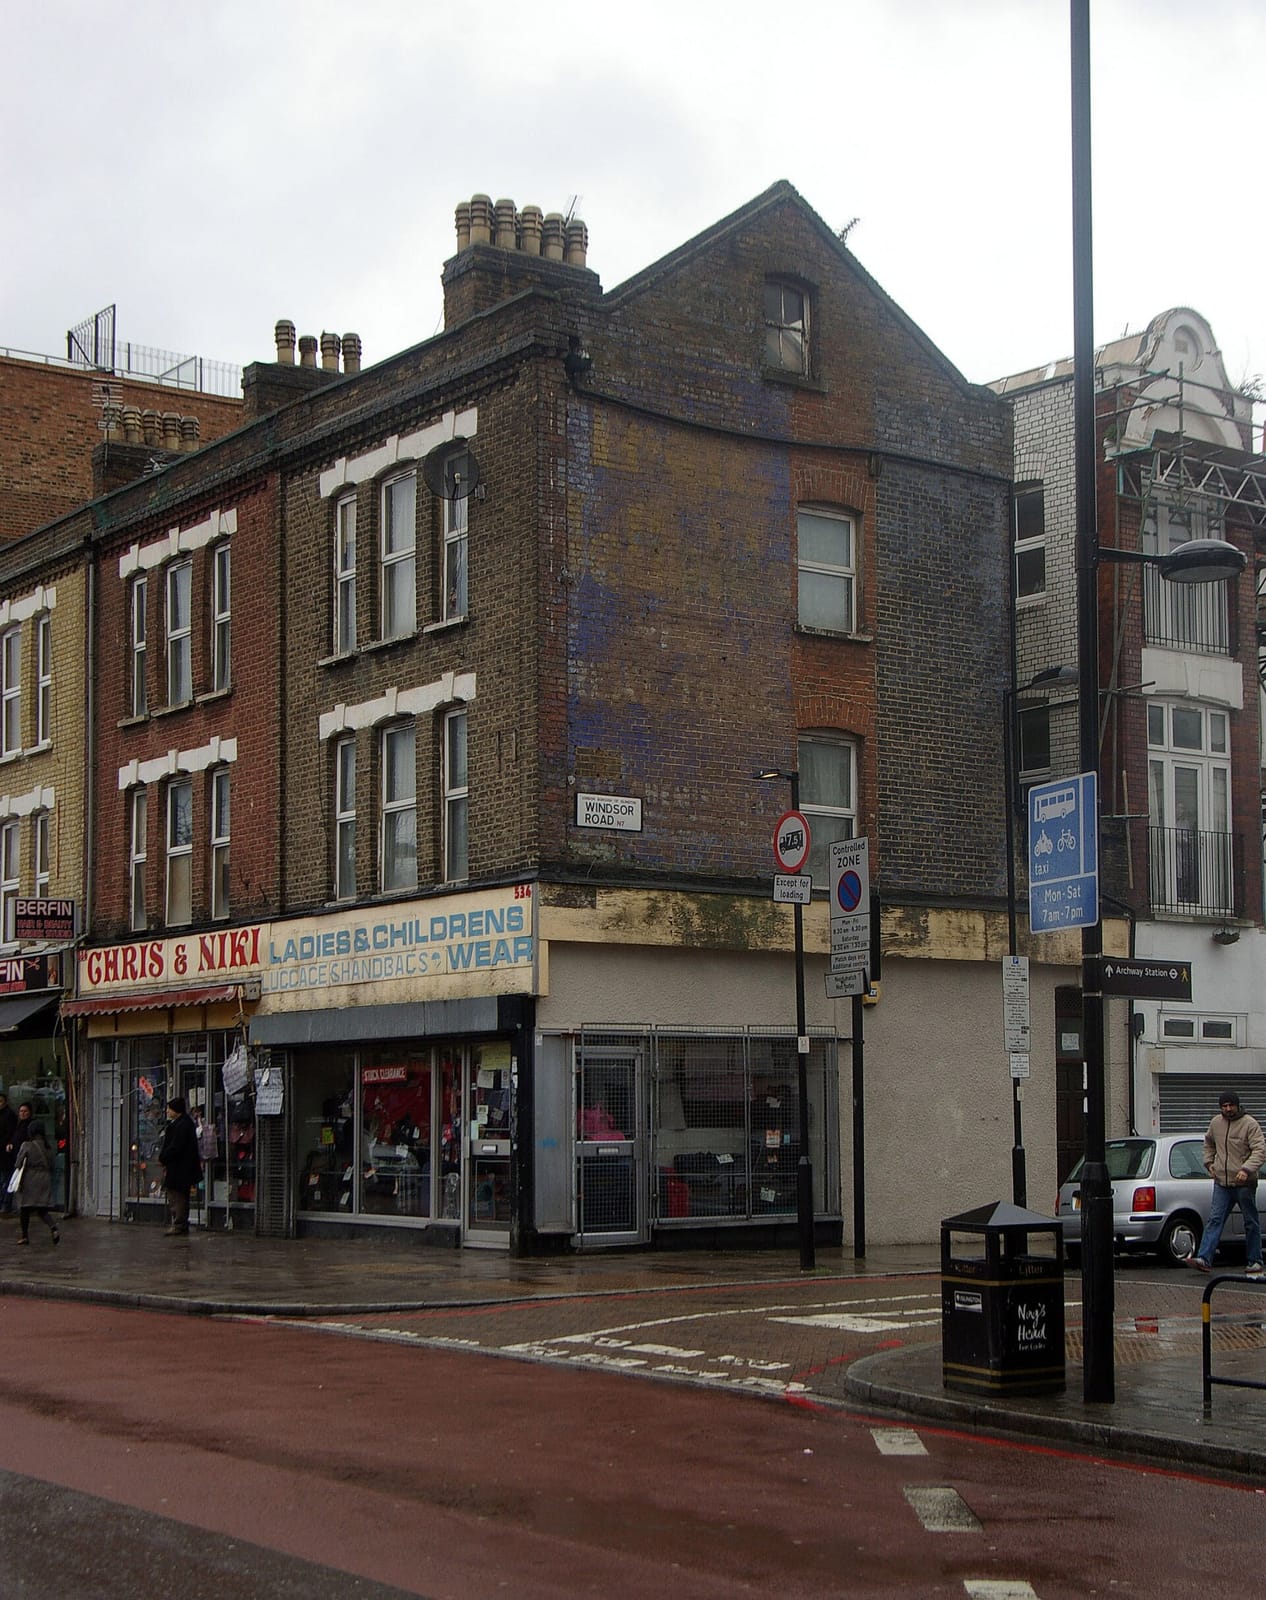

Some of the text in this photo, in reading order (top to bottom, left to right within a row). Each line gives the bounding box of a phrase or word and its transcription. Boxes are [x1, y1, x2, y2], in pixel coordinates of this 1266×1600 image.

[585, 802, 634, 816] WINDSOR
[584, 813, 614, 826] ROAD
[832, 841, 865, 856] Controlled
[837, 854, 860, 868] ZONE
[1034, 860, 1049, 876] taxi
[776, 878, 809, 888] Except for
[780, 889, 804, 900] loading
[1067, 884, 1081, 899] Sat
[16, 901, 72, 916] BERFIN
[88, 928, 260, 985] CHRIS & NIKI
[447, 936, 532, 970] WEAR
[1116, 965, 1168, 977] Archway Station
[1018, 1302, 1046, 1328] Nag's
[1018, 1323, 1047, 1342] Head
